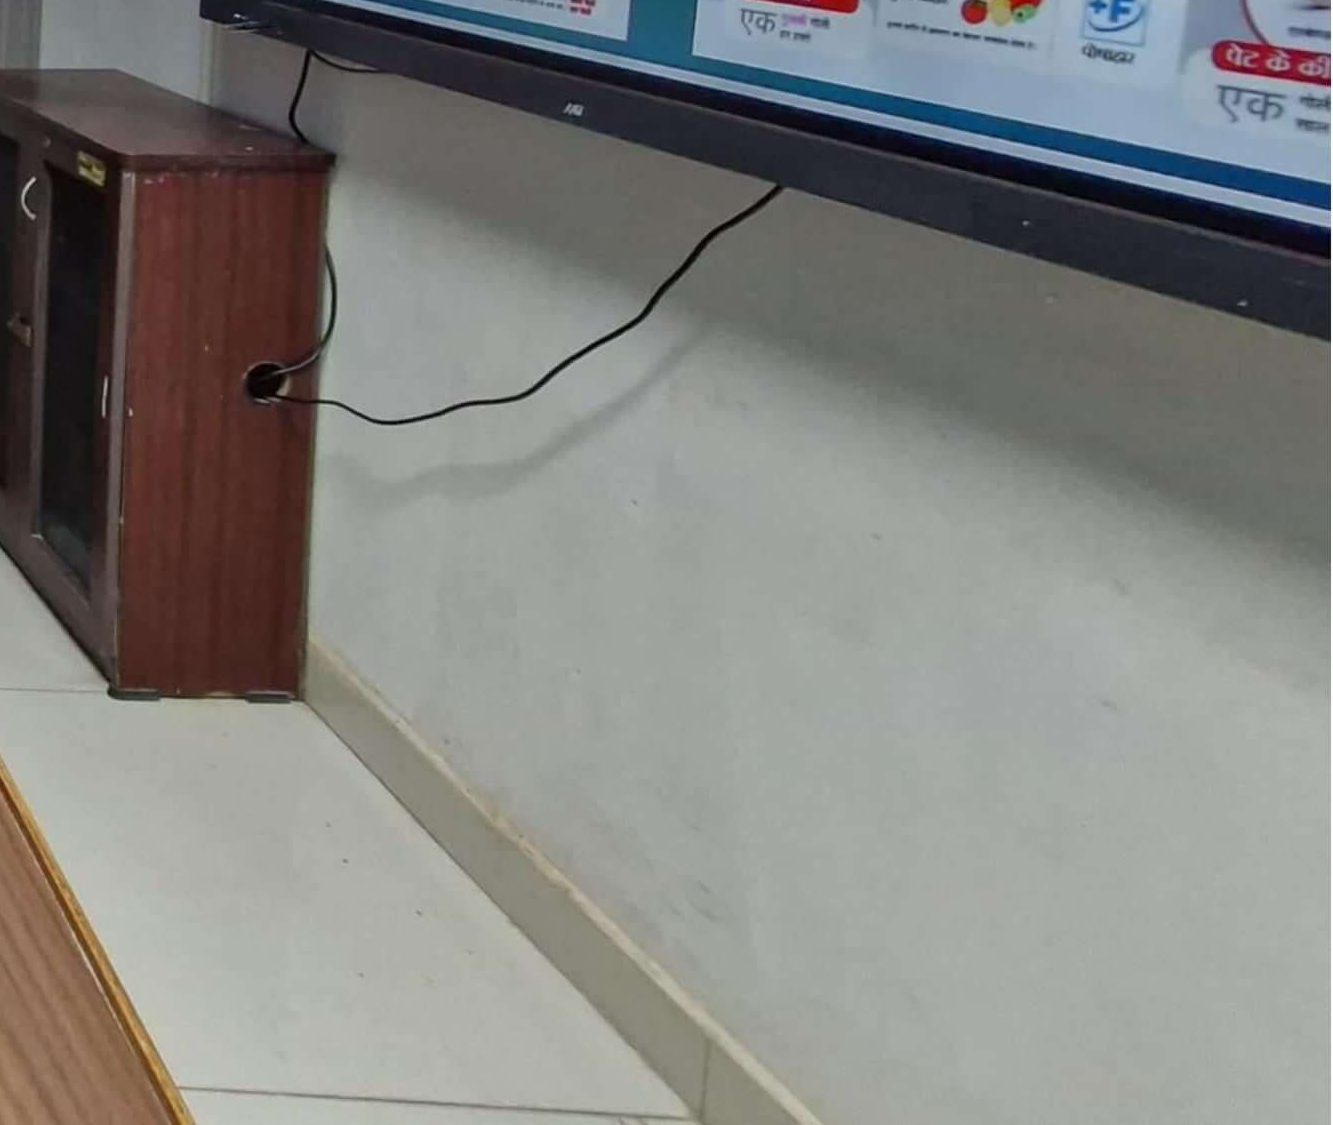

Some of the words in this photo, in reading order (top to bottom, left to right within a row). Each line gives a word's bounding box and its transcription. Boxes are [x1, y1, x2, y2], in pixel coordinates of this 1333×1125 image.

[739, 7, 778, 36] एक
[1225, 42, 1261, 68] पेट
[1265, 49, 1292, 72] के
[1217, 84, 1287, 123] एक
